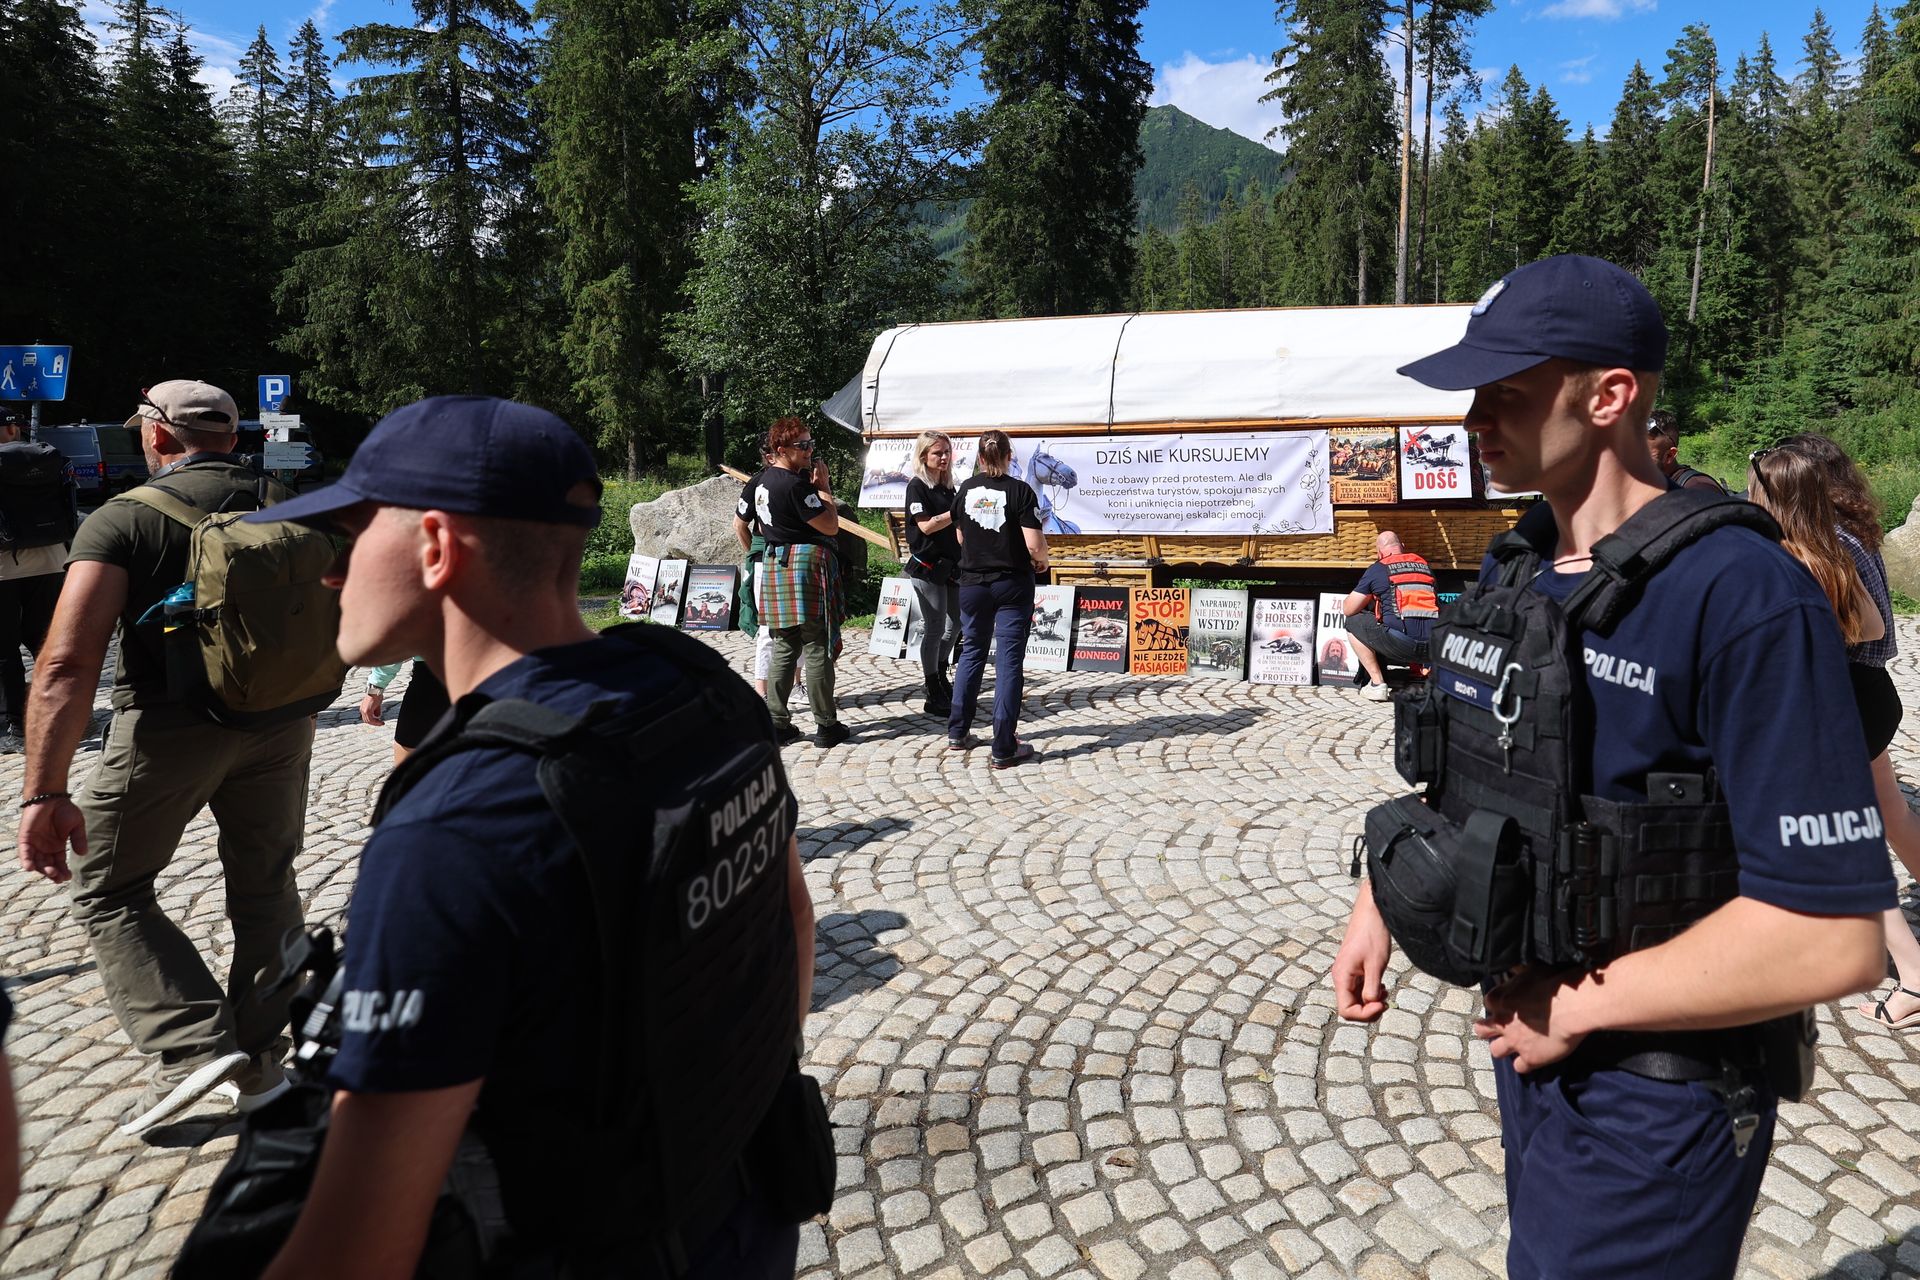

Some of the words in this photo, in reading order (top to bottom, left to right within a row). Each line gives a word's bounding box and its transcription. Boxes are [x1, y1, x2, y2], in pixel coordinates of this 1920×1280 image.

[266, 379, 283, 401] P
[874, 442, 914, 451] WYGOD
[1096, 447, 1132, 464] DZIŚ
[1137, 449, 1163, 463] NIE
[1169, 447, 1270, 462] KURSUJEMY
[1092, 476, 1107, 484] Nie
[1118, 476, 1149, 485] obawy
[1153, 475, 1179, 485] przed
[1183, 475, 1235, 484] protestem.
[1239, 473, 1254, 481] Ale
[1257, 473, 1272, 481] dla
[1415, 468, 1457, 490] DOŚĆ
[1079, 487, 1154, 497] bezpieczeństwa
[1158, 486, 1201, 497] turystów,
[1204, 486, 1242, 496] spokoju
[1245, 485, 1285, 495] naszych
[1135, 499, 1182, 508] uniknięcia
[1104, 511, 1183, 520] wyreżyserowanej
[1186, 510, 1228, 520] eskalacji
[1230, 510, 1266, 520] emocji.
[1135, 589, 1184, 603] FASIĄGI
[1079, 597, 1123, 611] ŻĄDAMY
[1135, 602, 1185, 618] STOP.
[1200, 600, 1241, 610] NAPRAWDĘ?
[1271, 602, 1297, 610] SAVE
[1209, 610, 1224, 618] JEST
[1226, 610, 1243, 618] WAM
[1265, 613, 1303, 623] HORSES
[1198, 619, 1239, 630] WSTYD?
[1026, 646, 1066, 656] KWIDACJI
[1074, 650, 1120, 660] KONNEGO
[1153, 652, 1184, 662] JEŻDŻĘ
[1441, 633, 1502, 676] POLICJA
[1134, 662, 1186, 675] FASIĄGIEM
[1584, 647, 1656, 696] POLICJ
[710, 764, 777, 847] POLICJA
